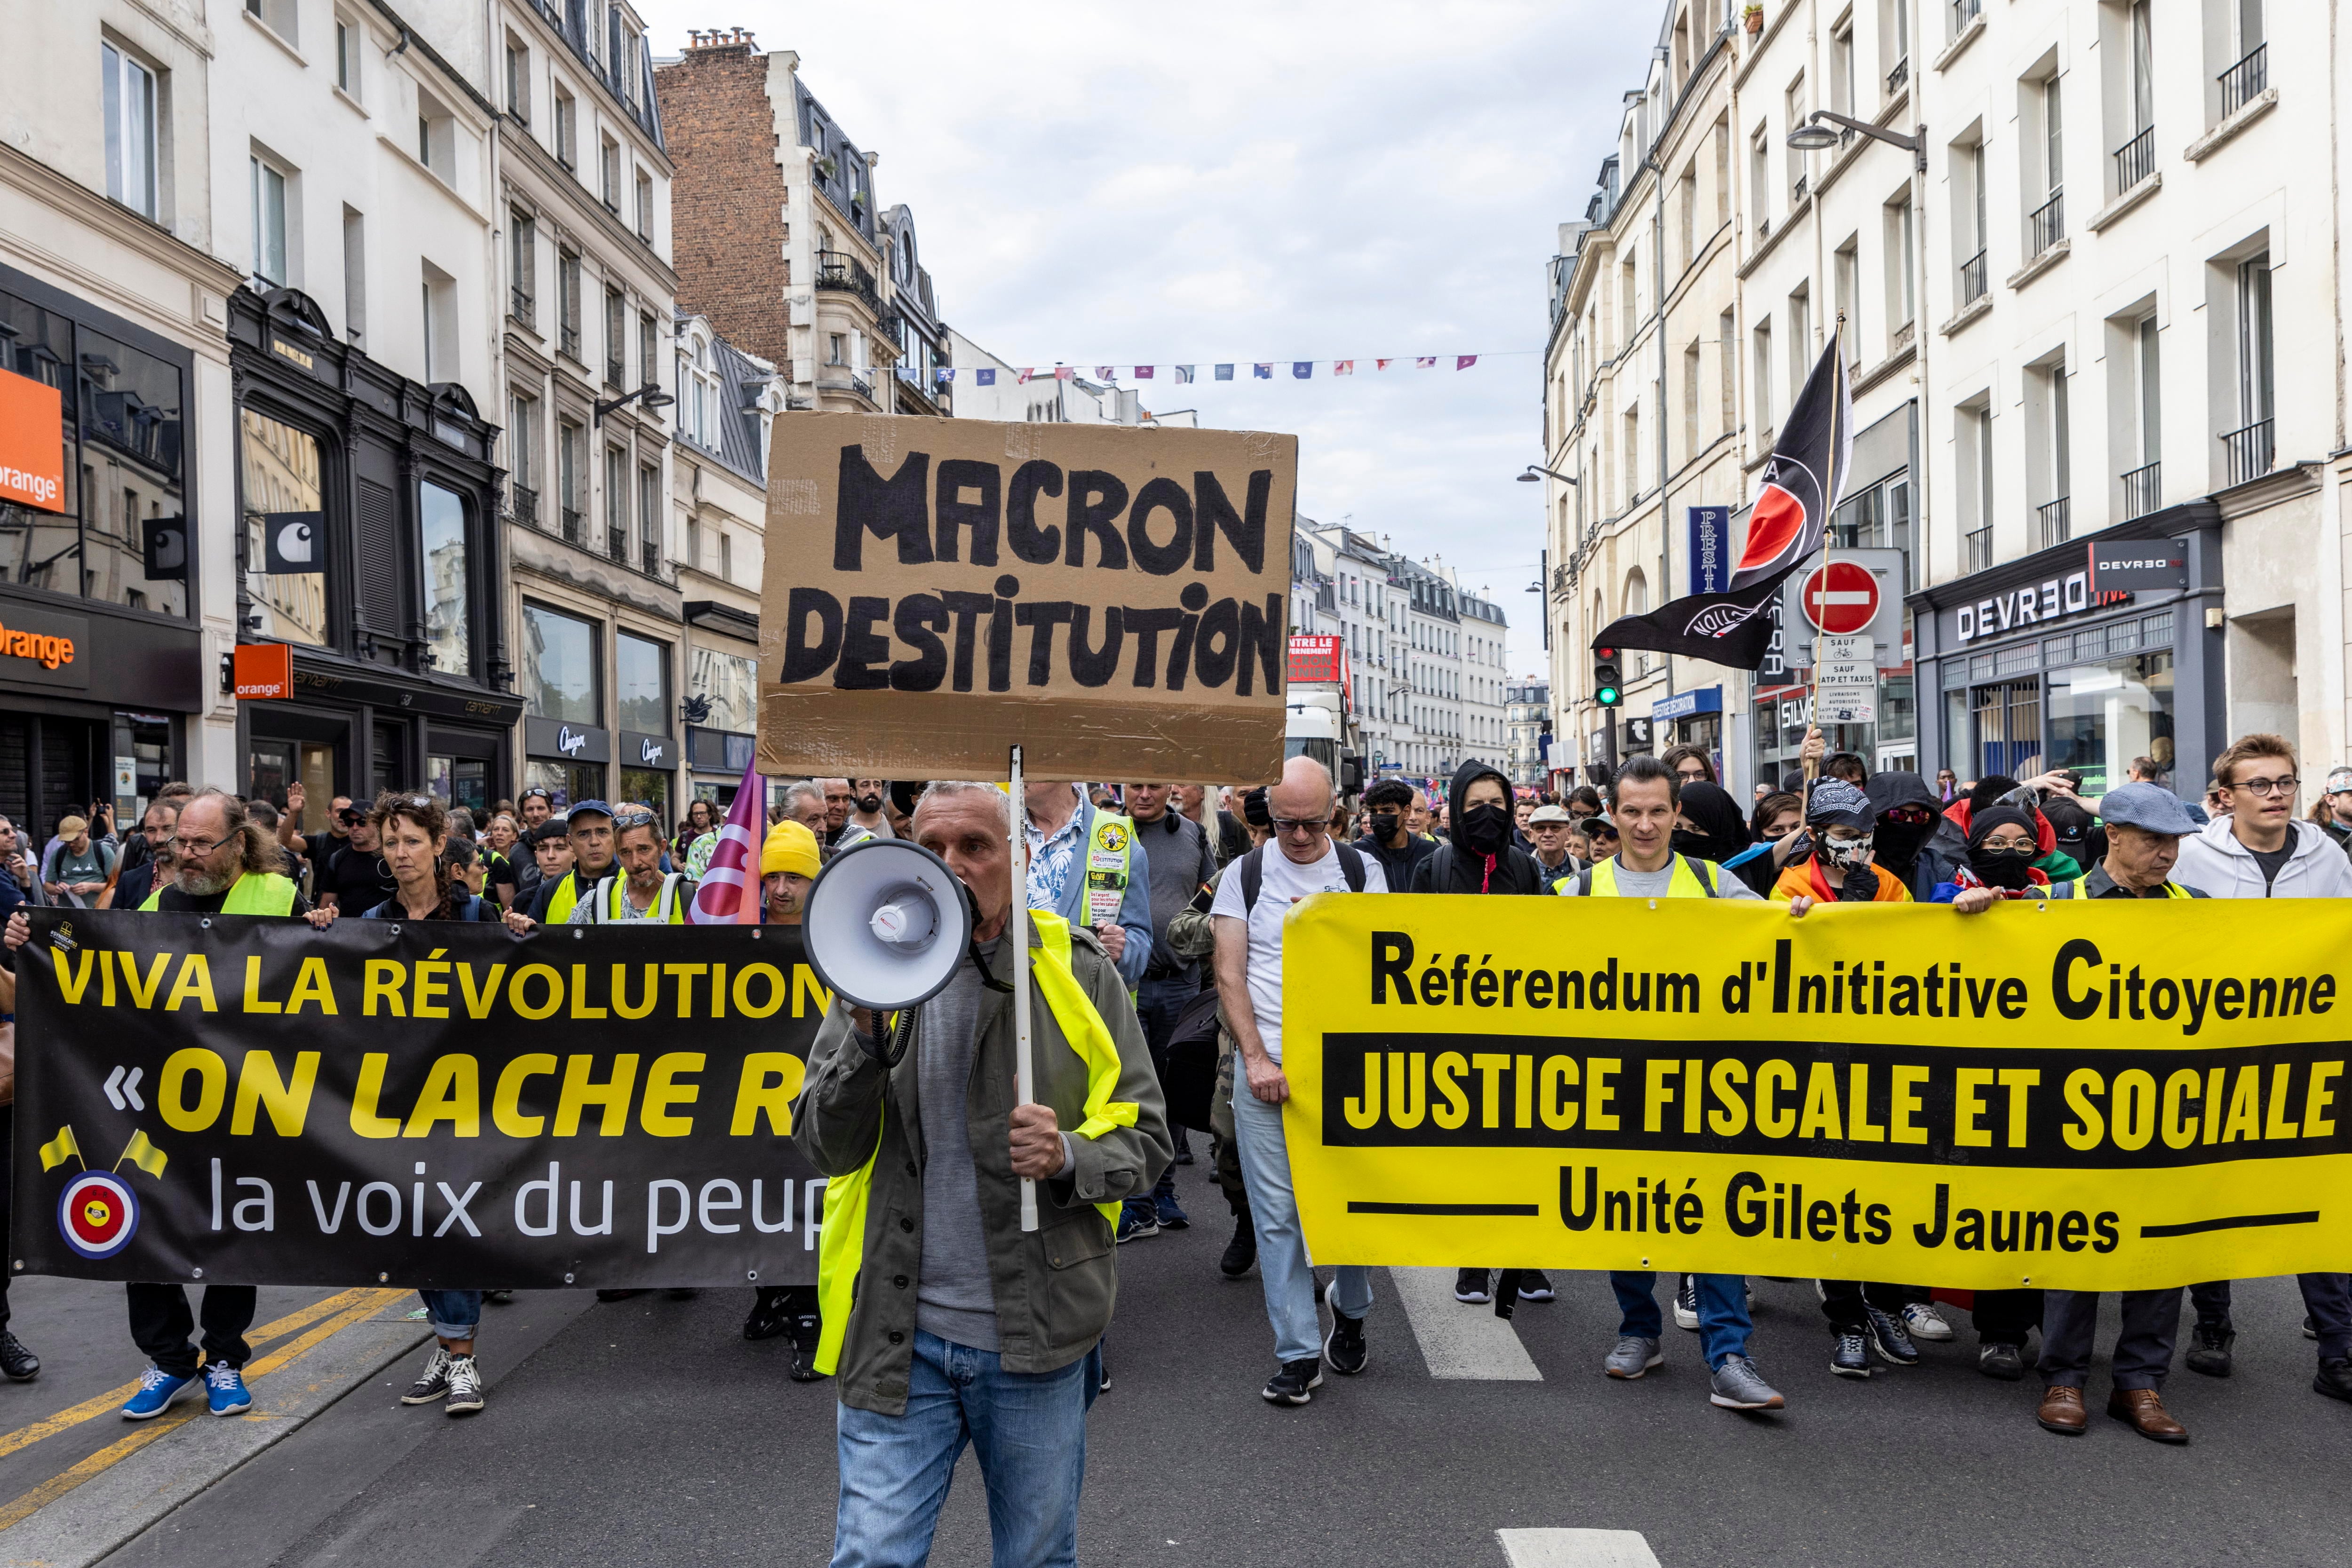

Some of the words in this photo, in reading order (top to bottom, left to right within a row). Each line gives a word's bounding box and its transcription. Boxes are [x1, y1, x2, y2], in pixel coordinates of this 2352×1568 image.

[0, 466, 56, 502] range
[833, 443, 1275, 576] MACRON
[1700, 511, 1718, 594] PRESTI
[1319, 637, 1333, 648] LE
[237, 684, 280, 697] orange
[1653, 702, 1670, 719] PRESTIGE
[1670, 695, 1695, 715] DÉCORATION
[50, 946, 219, 1012] VIVA
[243, 955, 339, 1015] LA
[363, 949, 834, 1020] RÉVOLUTION
[1371, 931, 1700, 1014] Référendum
[1722, 939, 2027, 1020] d'Initiative
[2052, 939, 2336, 1036] Citoyenne
[349, 1052, 707, 1139] LACHE
[1344, 1051, 1621, 1131] JUSTICE
[1644, 1058, 1930, 1145] FISCALE
[1954, 1068, 2041, 1148] ET
[2062, 1061, 2344, 1151] SOCIALE
[211, 1157, 274, 1231] la
[306, 1161, 483, 1237] voix
[514, 1161, 613, 1237] du
[1559, 1166, 1703, 1235] Unité
[1725, 1171, 1891, 1245] Gilets
[1913, 1183, 2120, 1253] Jaunes
